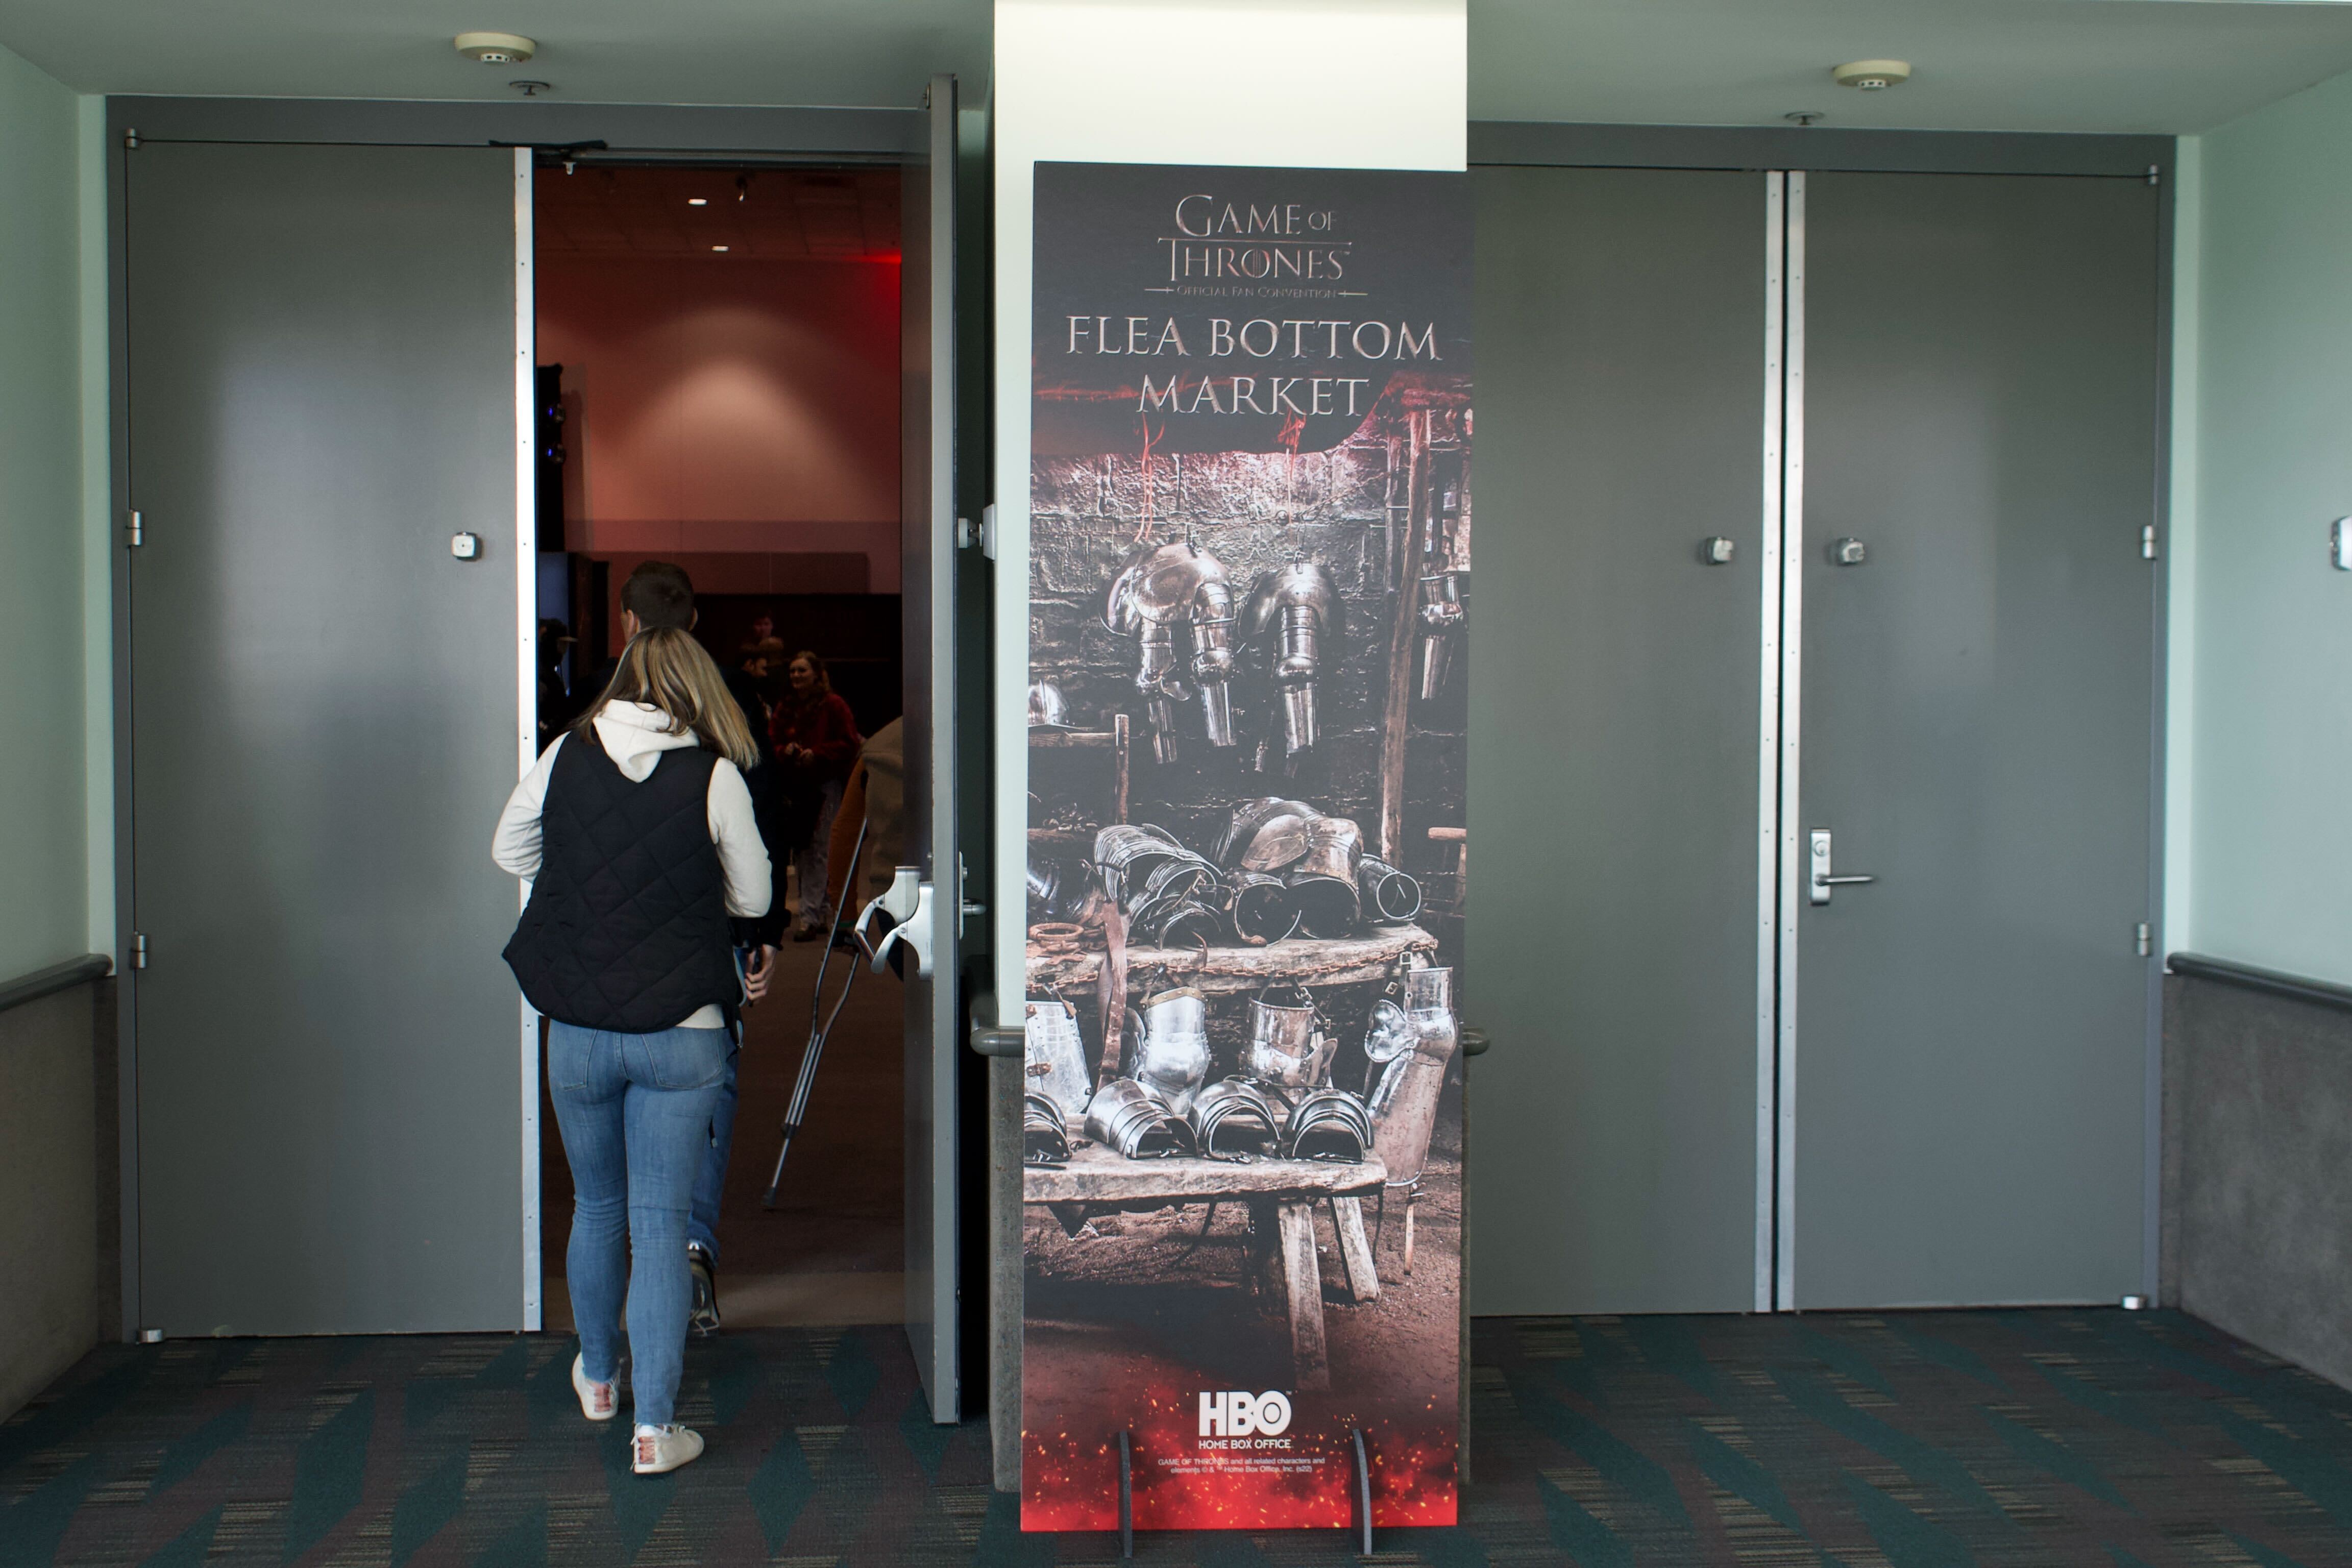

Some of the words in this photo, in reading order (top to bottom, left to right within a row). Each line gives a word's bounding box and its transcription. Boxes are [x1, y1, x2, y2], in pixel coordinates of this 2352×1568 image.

[1175, 194, 1301, 237] GAME
[1308, 211, 1337, 231] OF
[1158, 237, 1352, 281] THRONES
[1177, 285, 1225, 297] OFFICIAL
[1232, 286, 1254, 297] FAN
[1258, 286, 1337, 299] CONVENTION
[1066, 315, 1189, 356] FLEA
[1208, 318, 1442, 361] BOTTOM
[1136, 374, 1369, 416] MARKET
[1198, 1390, 1292, 1437] HBO
[1198, 1440, 1228, 1450] HOME
[1231, 1439, 1252, 1450] BOX
[1254, 1439, 1291, 1449] OFFICE
